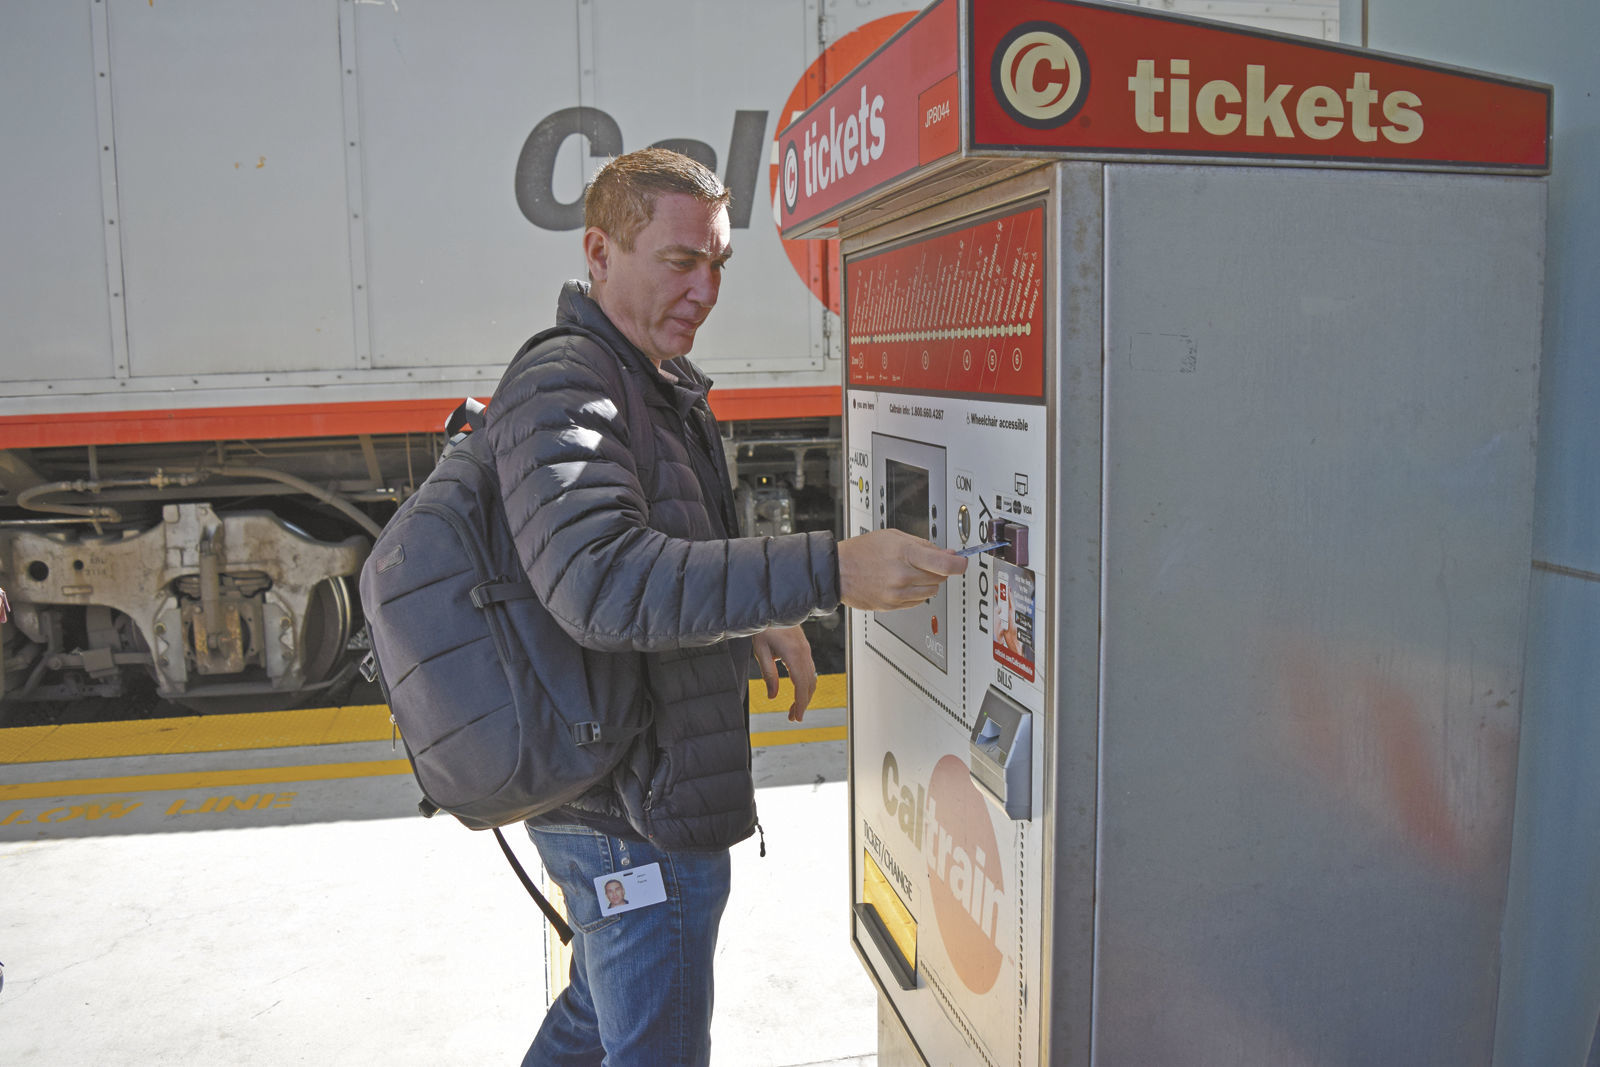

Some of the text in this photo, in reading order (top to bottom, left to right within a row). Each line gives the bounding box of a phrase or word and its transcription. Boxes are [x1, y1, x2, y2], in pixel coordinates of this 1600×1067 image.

[925, 100, 950, 128] JPB044
[1128, 59, 1424, 144] tickets
[804, 85, 885, 197] tickets
[1028, 288, 1039, 319] Gilroy
[970, 413, 1029, 431] Wheelchair accessible
[854, 452, 868, 467] AUDIO
[956, 475, 972, 492] COIN
[997, 668, 1013, 690] BILLS
[165, 792, 297, 815] LINE
[882, 751, 1005, 952] Caltrain
